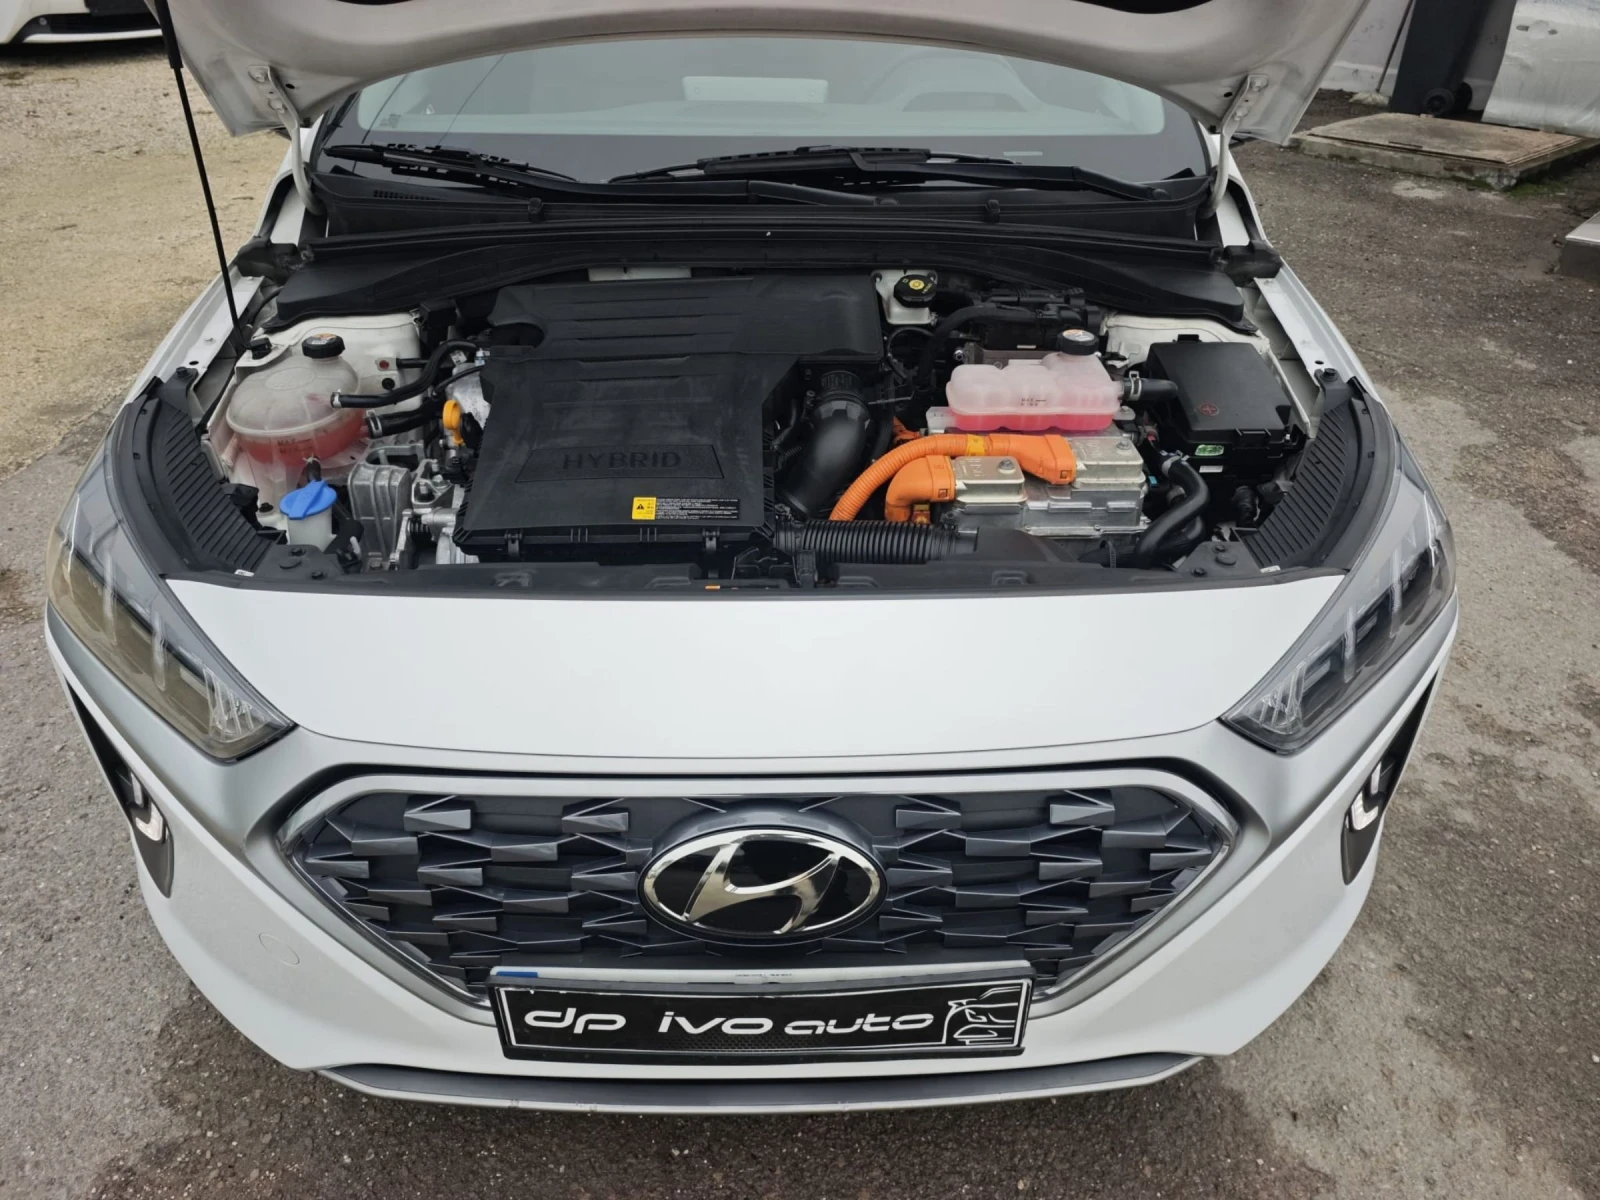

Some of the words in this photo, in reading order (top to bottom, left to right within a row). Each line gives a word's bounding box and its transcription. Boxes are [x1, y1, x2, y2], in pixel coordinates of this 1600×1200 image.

[562, 451, 682, 470] HYBRID
[524, 1007, 627, 1034] dp
[658, 1011, 774, 1035] ivo
[784, 1013, 934, 1035] auto
